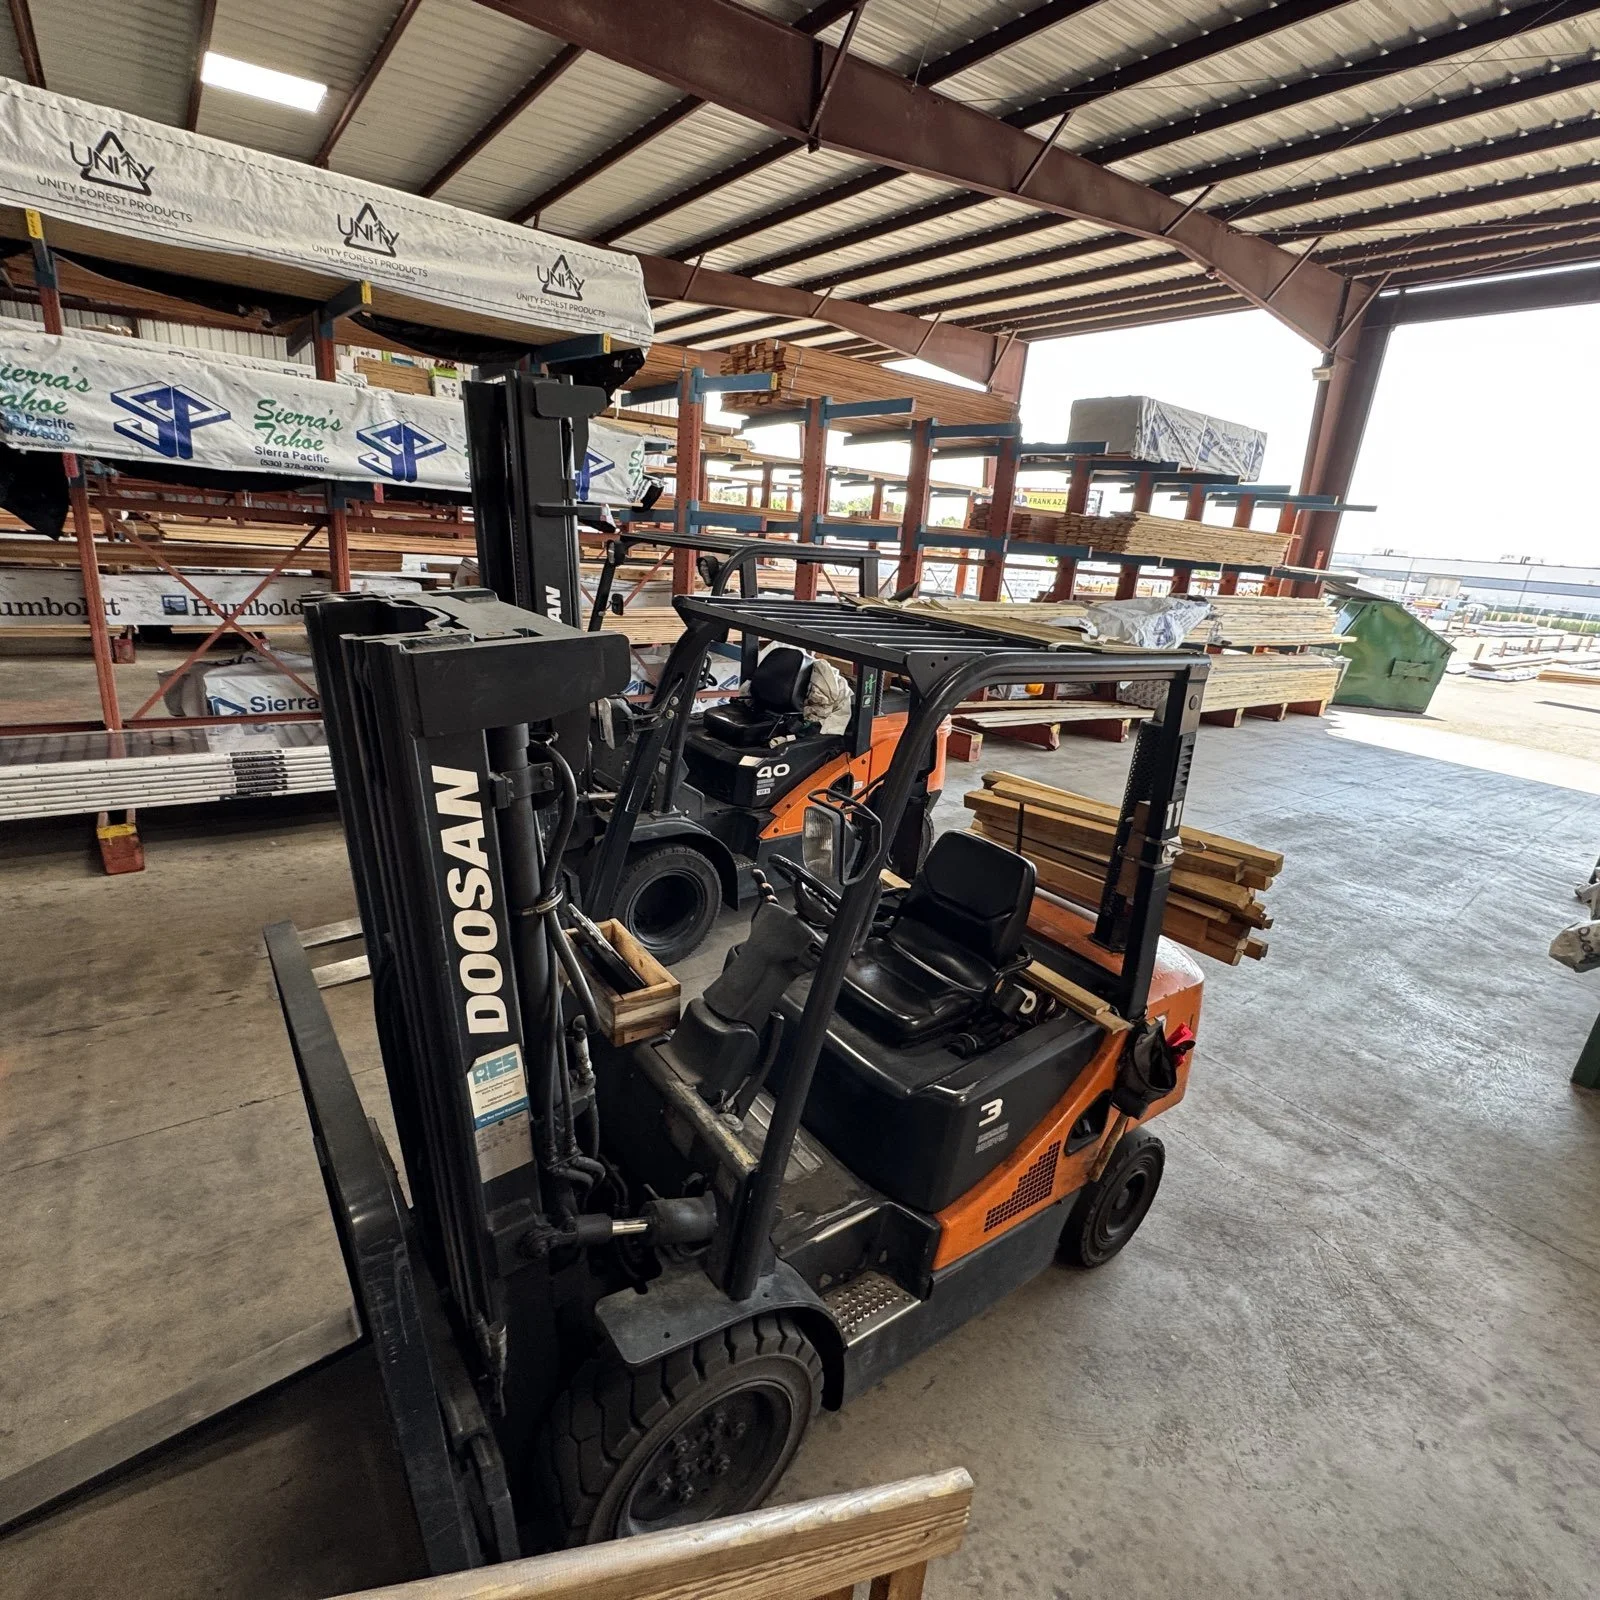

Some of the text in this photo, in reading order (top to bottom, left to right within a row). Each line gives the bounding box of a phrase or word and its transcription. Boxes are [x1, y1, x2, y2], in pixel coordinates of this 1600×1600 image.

[36, 175, 193, 223] UNITY FOREST PRODUCTS
[311, 243, 429, 277] UNITY FOREST PRODUCTS
[516, 292, 539, 304] UNITY
[540, 297, 568, 310] FOREST
[569, 304, 606, 318] PRODUCTS
[0, 363, 92, 393] ierra's
[0, 388, 69, 415] ahoe
[253, 399, 344, 432] Sierra's
[254, 422, 325, 451] Tahoe
[254, 446, 330, 464] Sierra Pacific
[260, 458, 325, 472] (530) 378-8000
[1028, 497, 1051, 505] FRANK
[0, 596, 121, 617] umbolt
[190, 598, 304, 616] Humbold
[250, 695, 320, 713] Sierra
[756, 763, 790, 779] 40
[1165, 800, 1183, 830] 11
[431, 764, 509, 1034] DOOSAN
[979, 1098, 1003, 1127] 3
